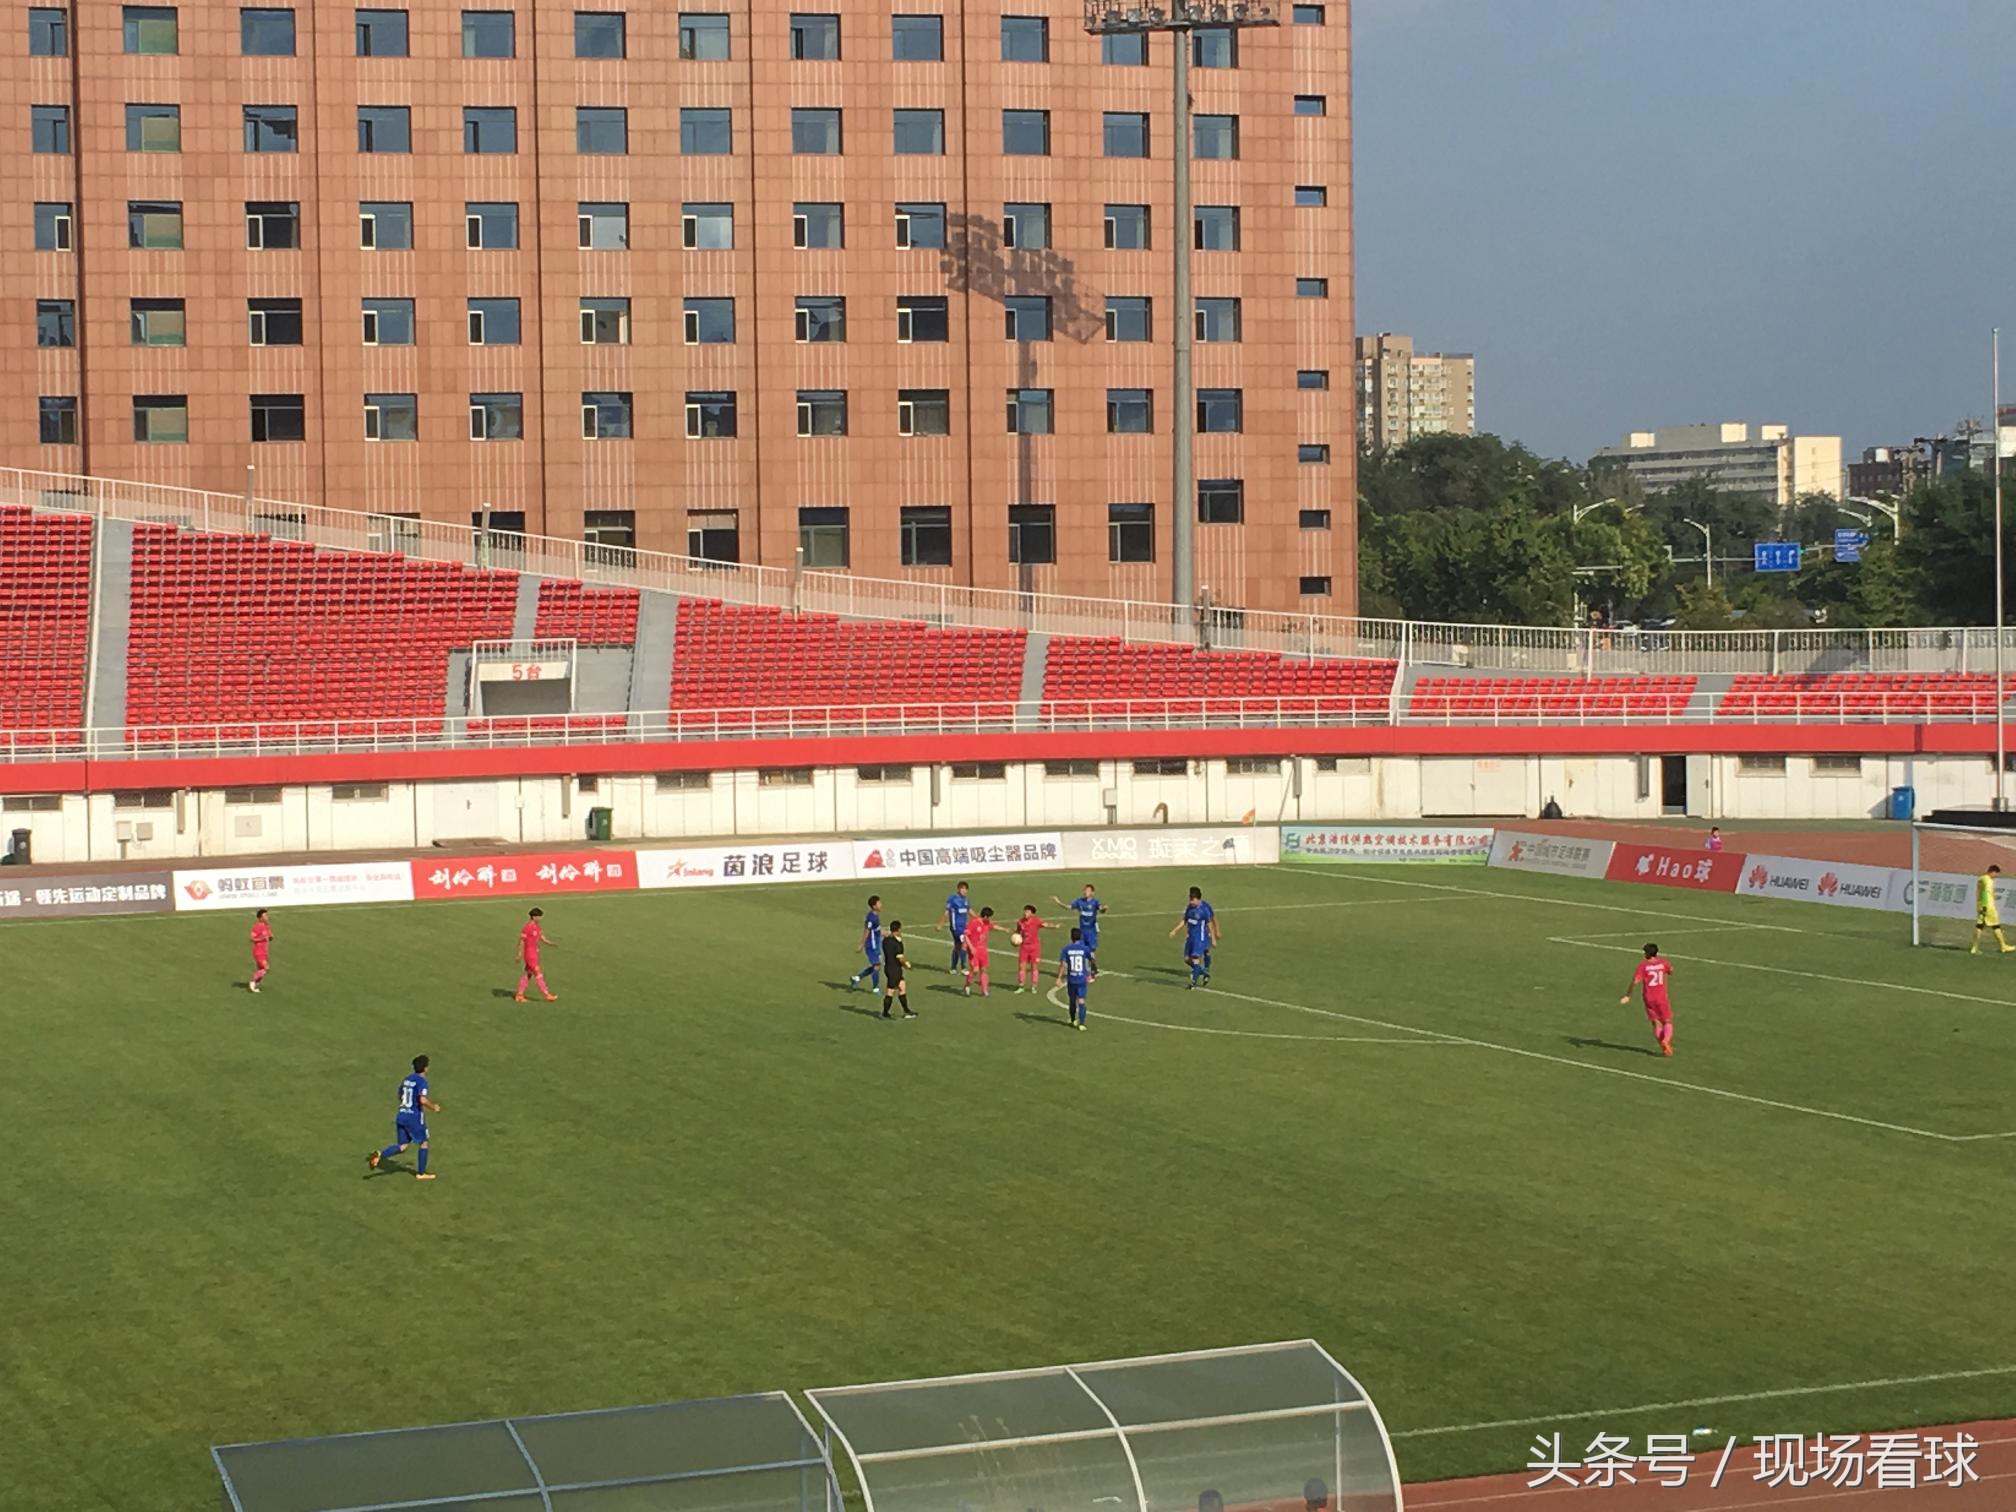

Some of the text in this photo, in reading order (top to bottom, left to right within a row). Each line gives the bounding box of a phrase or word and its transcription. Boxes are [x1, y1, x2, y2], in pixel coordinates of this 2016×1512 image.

[512, 662, 542, 682] 5台
[722, 850, 829, 878] 茵浪足球
[899, 842, 1058, 868] 中国高端吸尘器品牌
[1768, 874, 1810, 891] HUAWEI
[1840, 881, 1882, 899] HUAWEI
[1069, 955, 1083, 972] 18
[1648, 970, 1664, 987] 21
